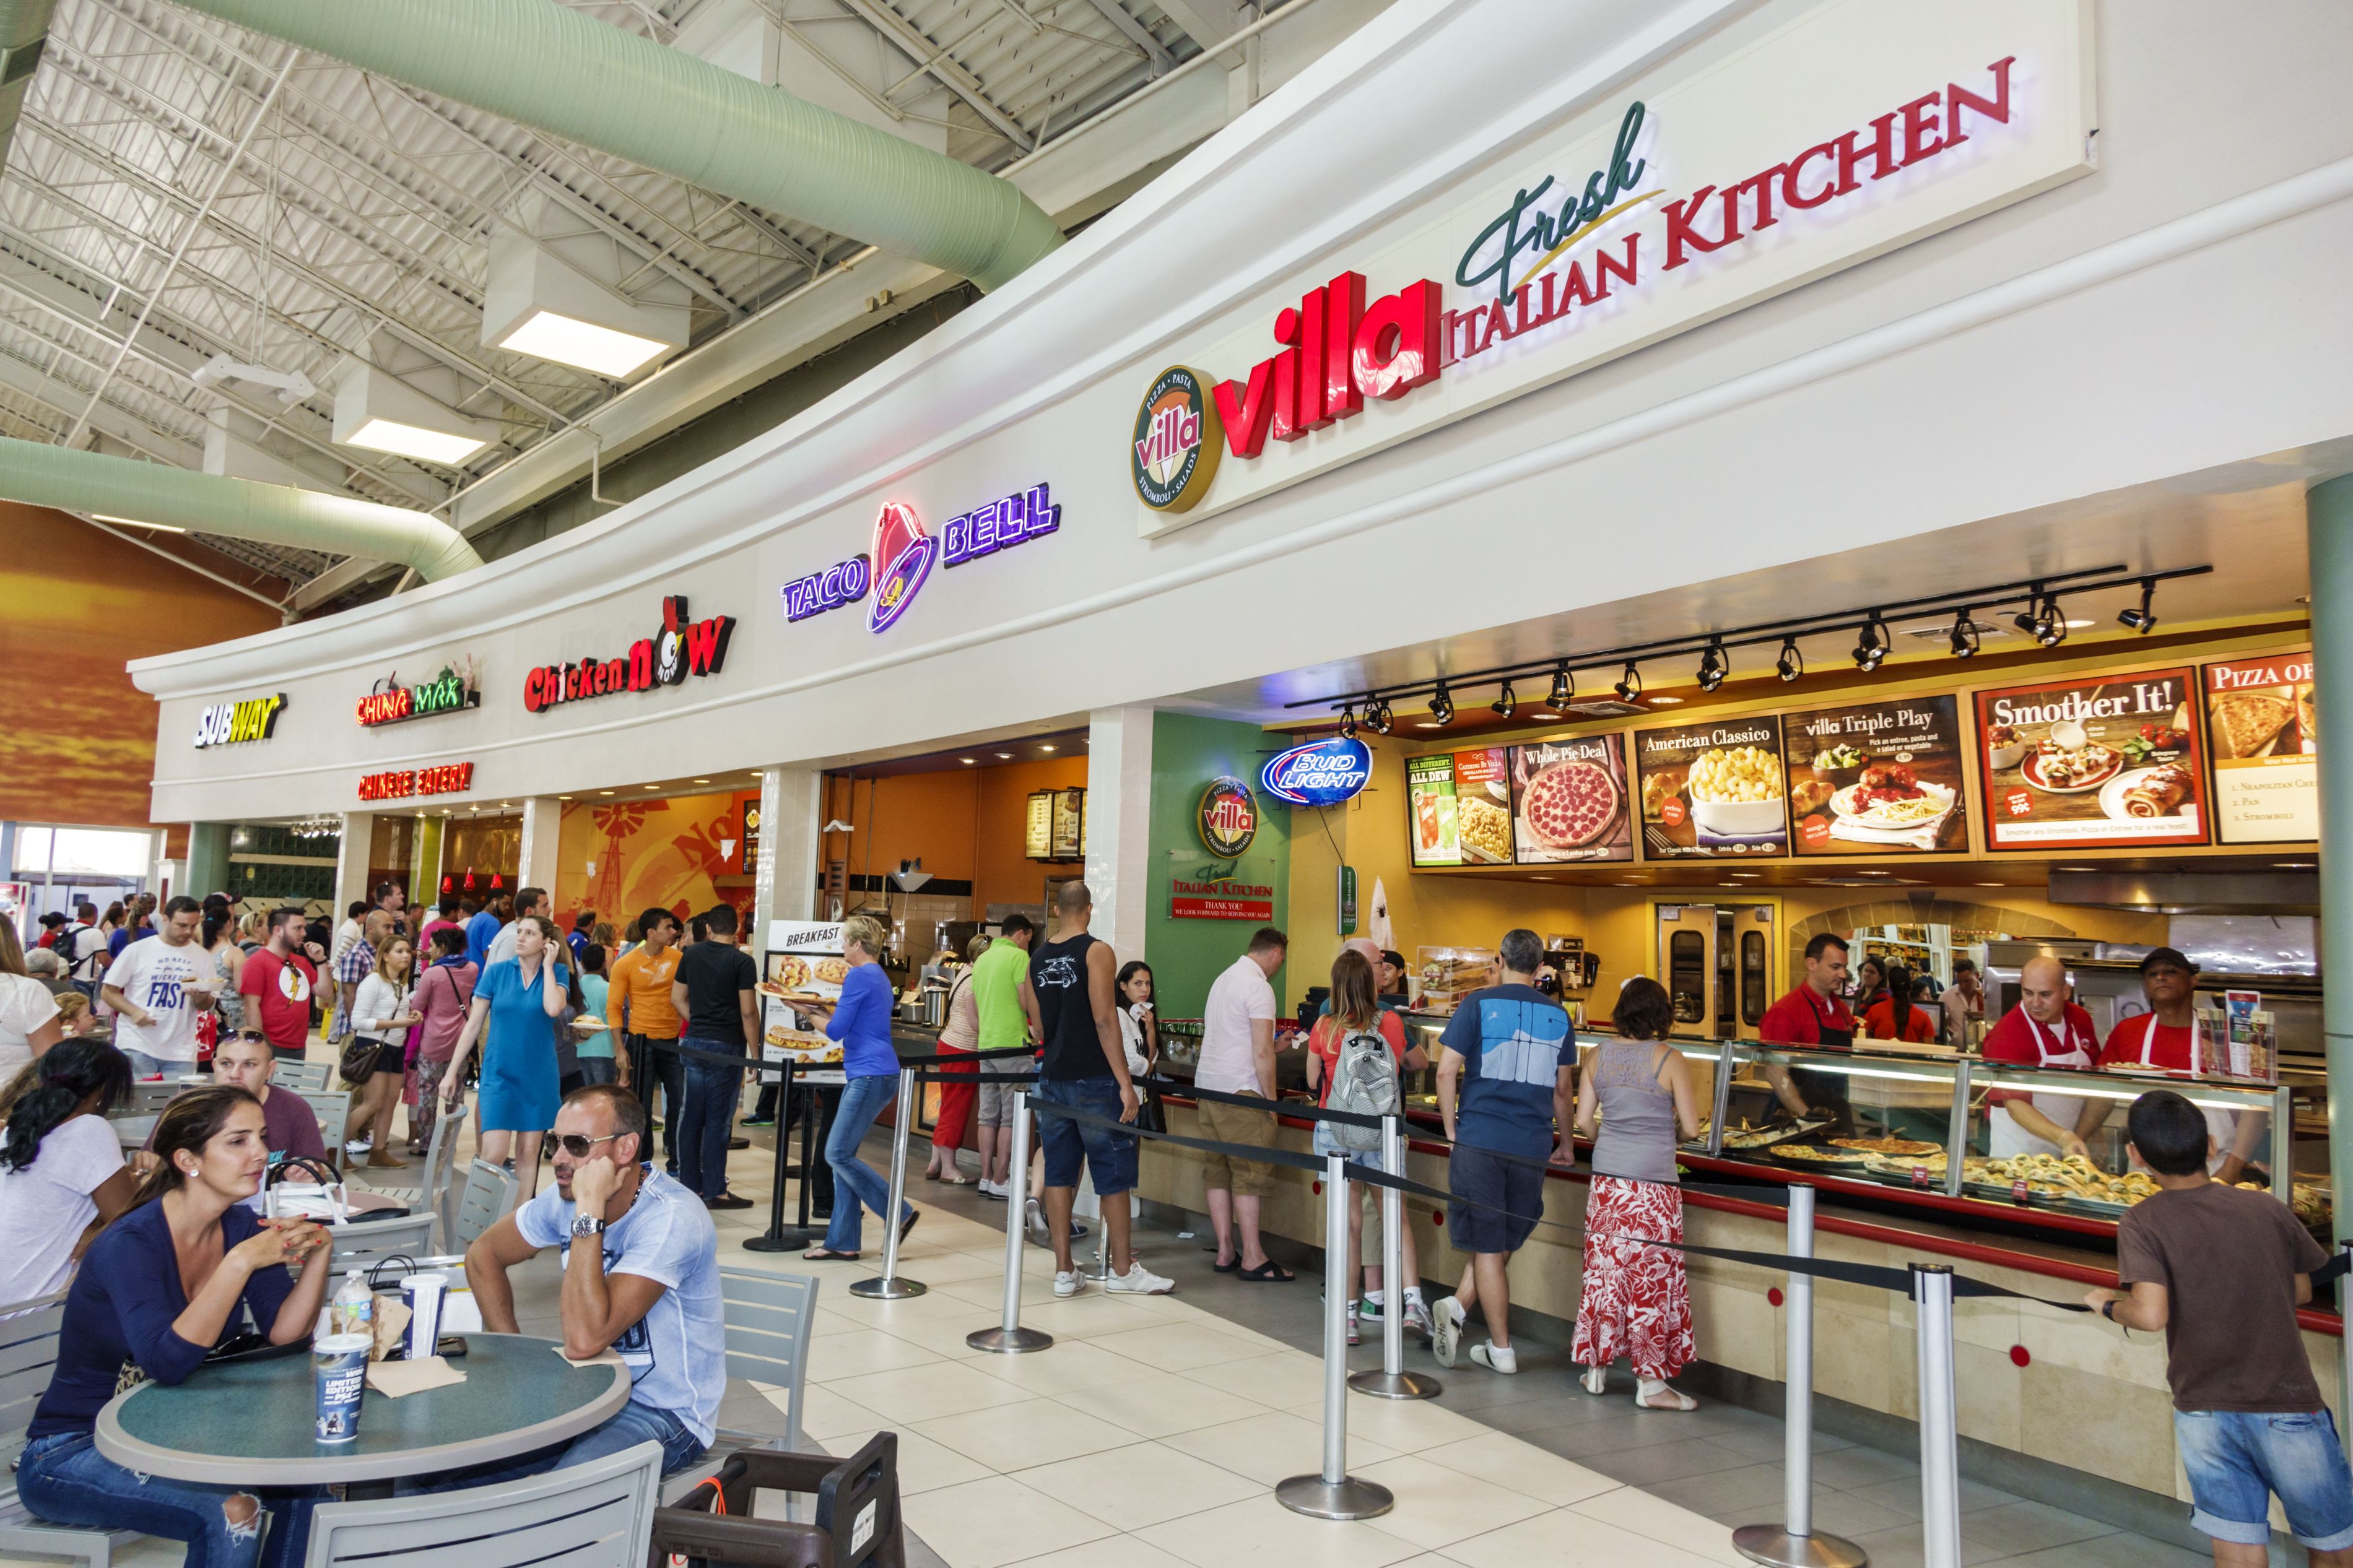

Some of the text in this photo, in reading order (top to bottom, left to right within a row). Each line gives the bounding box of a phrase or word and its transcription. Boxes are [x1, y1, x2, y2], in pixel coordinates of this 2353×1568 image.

[1438, 56, 2017, 371] ITALIAN KITCHEN
[1455, 100, 1646, 306] Fresh
[1213, 270, 1442, 461] villa
[1147, 374, 1191, 409] PIZZA PASTA
[1136, 411, 1199, 470] villa
[1139, 452, 1196, 503] STROMBOLI SALADS
[780, 482, 1061, 623] TACO BELL
[658, 656, 678, 682] NOW
[2213, 667, 2280, 689] PIZZA
[524, 657, 624, 713] Chicken
[2299, 686, 2306, 694] 2
[355, 677, 463, 727] CHINA MAX
[1994, 682, 2173, 728] Smother It!
[194, 693, 287, 749] SUBWAY
[1806, 709, 1933, 736] villa Triple Play
[1645, 727, 1770, 752] American Classico
[1904, 742, 1932, 751] vegetable
[1910, 735, 1925, 743] pasta
[1926, 733, 1938, 741] and
[1292, 753, 1356, 772] BUD
[1525, 743, 1607, 765] Whole Pie Deal
[358, 761, 474, 800] CHINESE EATERY
[1278, 771, 1365, 789] LIGHT
[1411, 772, 1427, 784] ALL
[1429, 769, 1451, 782] DEW
[2240, 782, 2293, 791] NEAPOLITAN
[1214, 785, 1248, 799] PIZZA PASTA
[2242, 797, 2259, 806] PAN
[1204, 804, 1252, 831] villa
[2011, 802, 2030, 815] 99¢
[2243, 812, 2294, 821] STROMBOLI
[1207, 831, 1250, 853] STROMBOLI SALADS
[1173, 879, 1272, 898] ITALIAN KITCHEN
[1205, 901, 1243, 911] THANK YOU!
[786, 927, 840, 947] BREAKFAST
[173, 957, 191, 965] REST
[326, 1376, 362, 1387] LIMITED
[346, 1367, 364, 1378] WIN
[325, 1382, 362, 1394] EDITION
